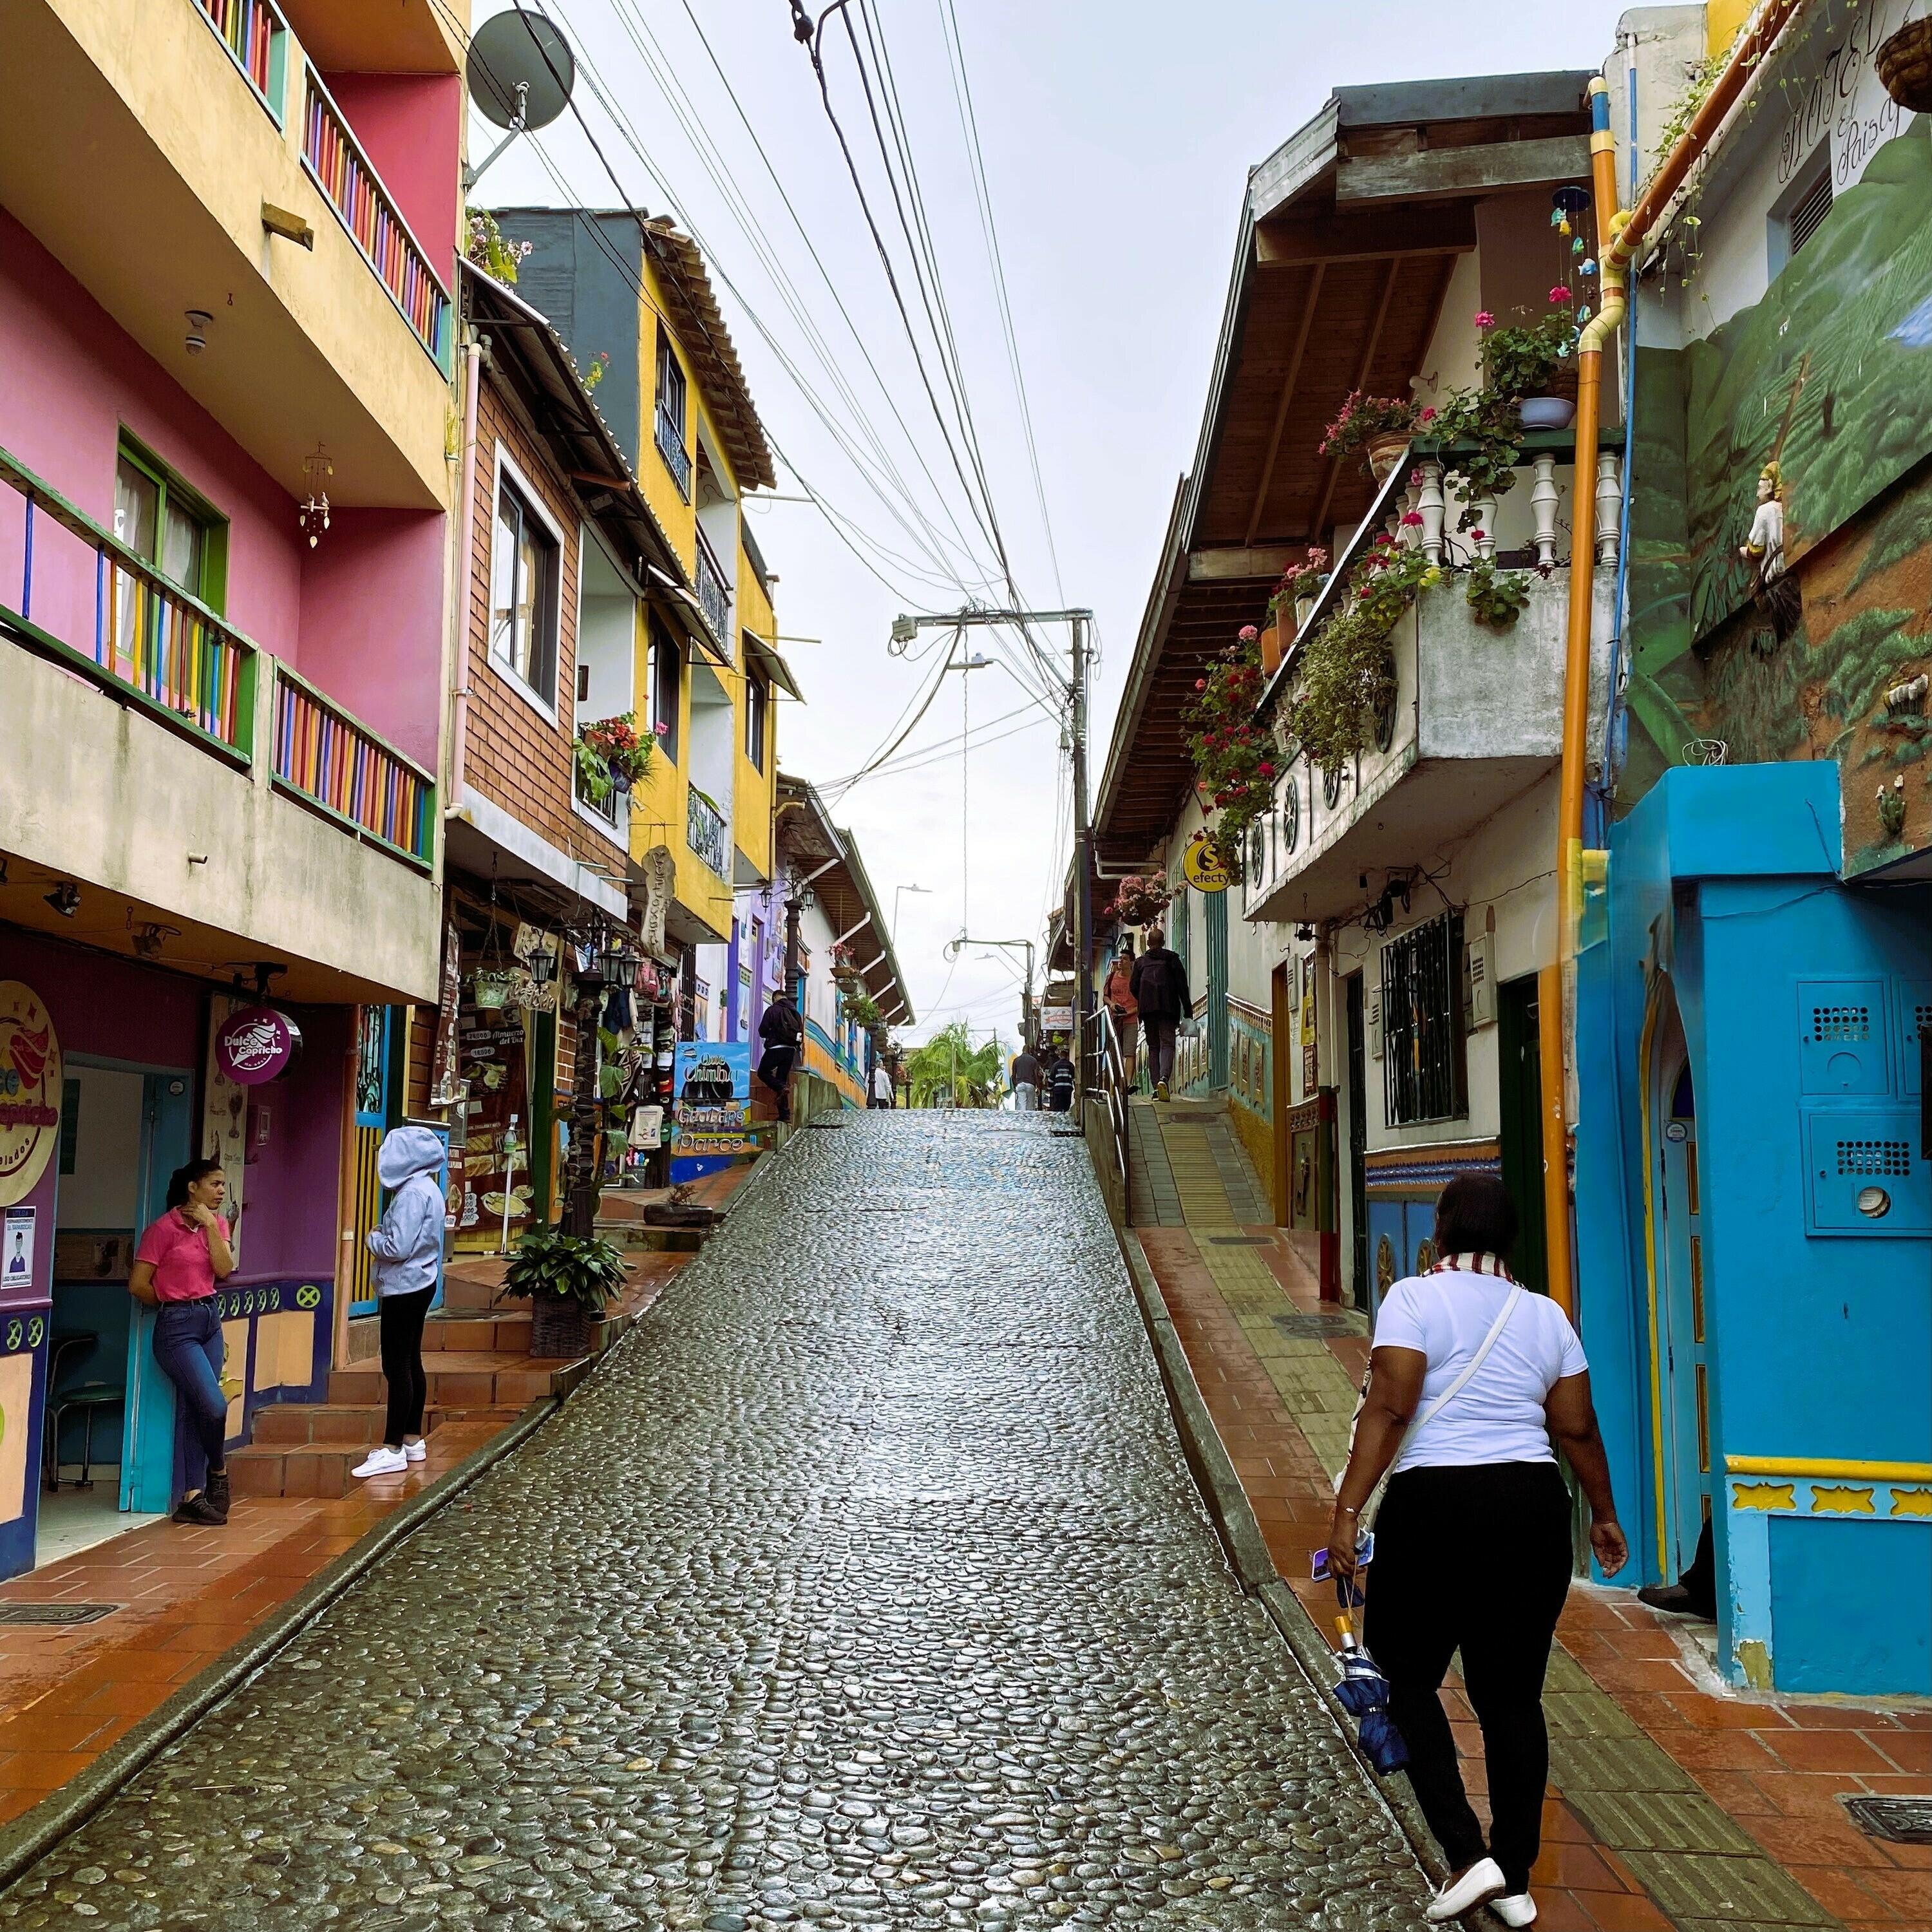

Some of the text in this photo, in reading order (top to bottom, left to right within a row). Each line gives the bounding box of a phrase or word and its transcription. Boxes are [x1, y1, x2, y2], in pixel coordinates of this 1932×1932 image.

[1193, 872, 1229, 886] efecty
[224, 1036, 258, 1046] Dulce
[238, 1045, 283, 1057] Capricho
[684, 1066, 740, 1083] Chimba
[677, 1132, 744, 1154] Parce
